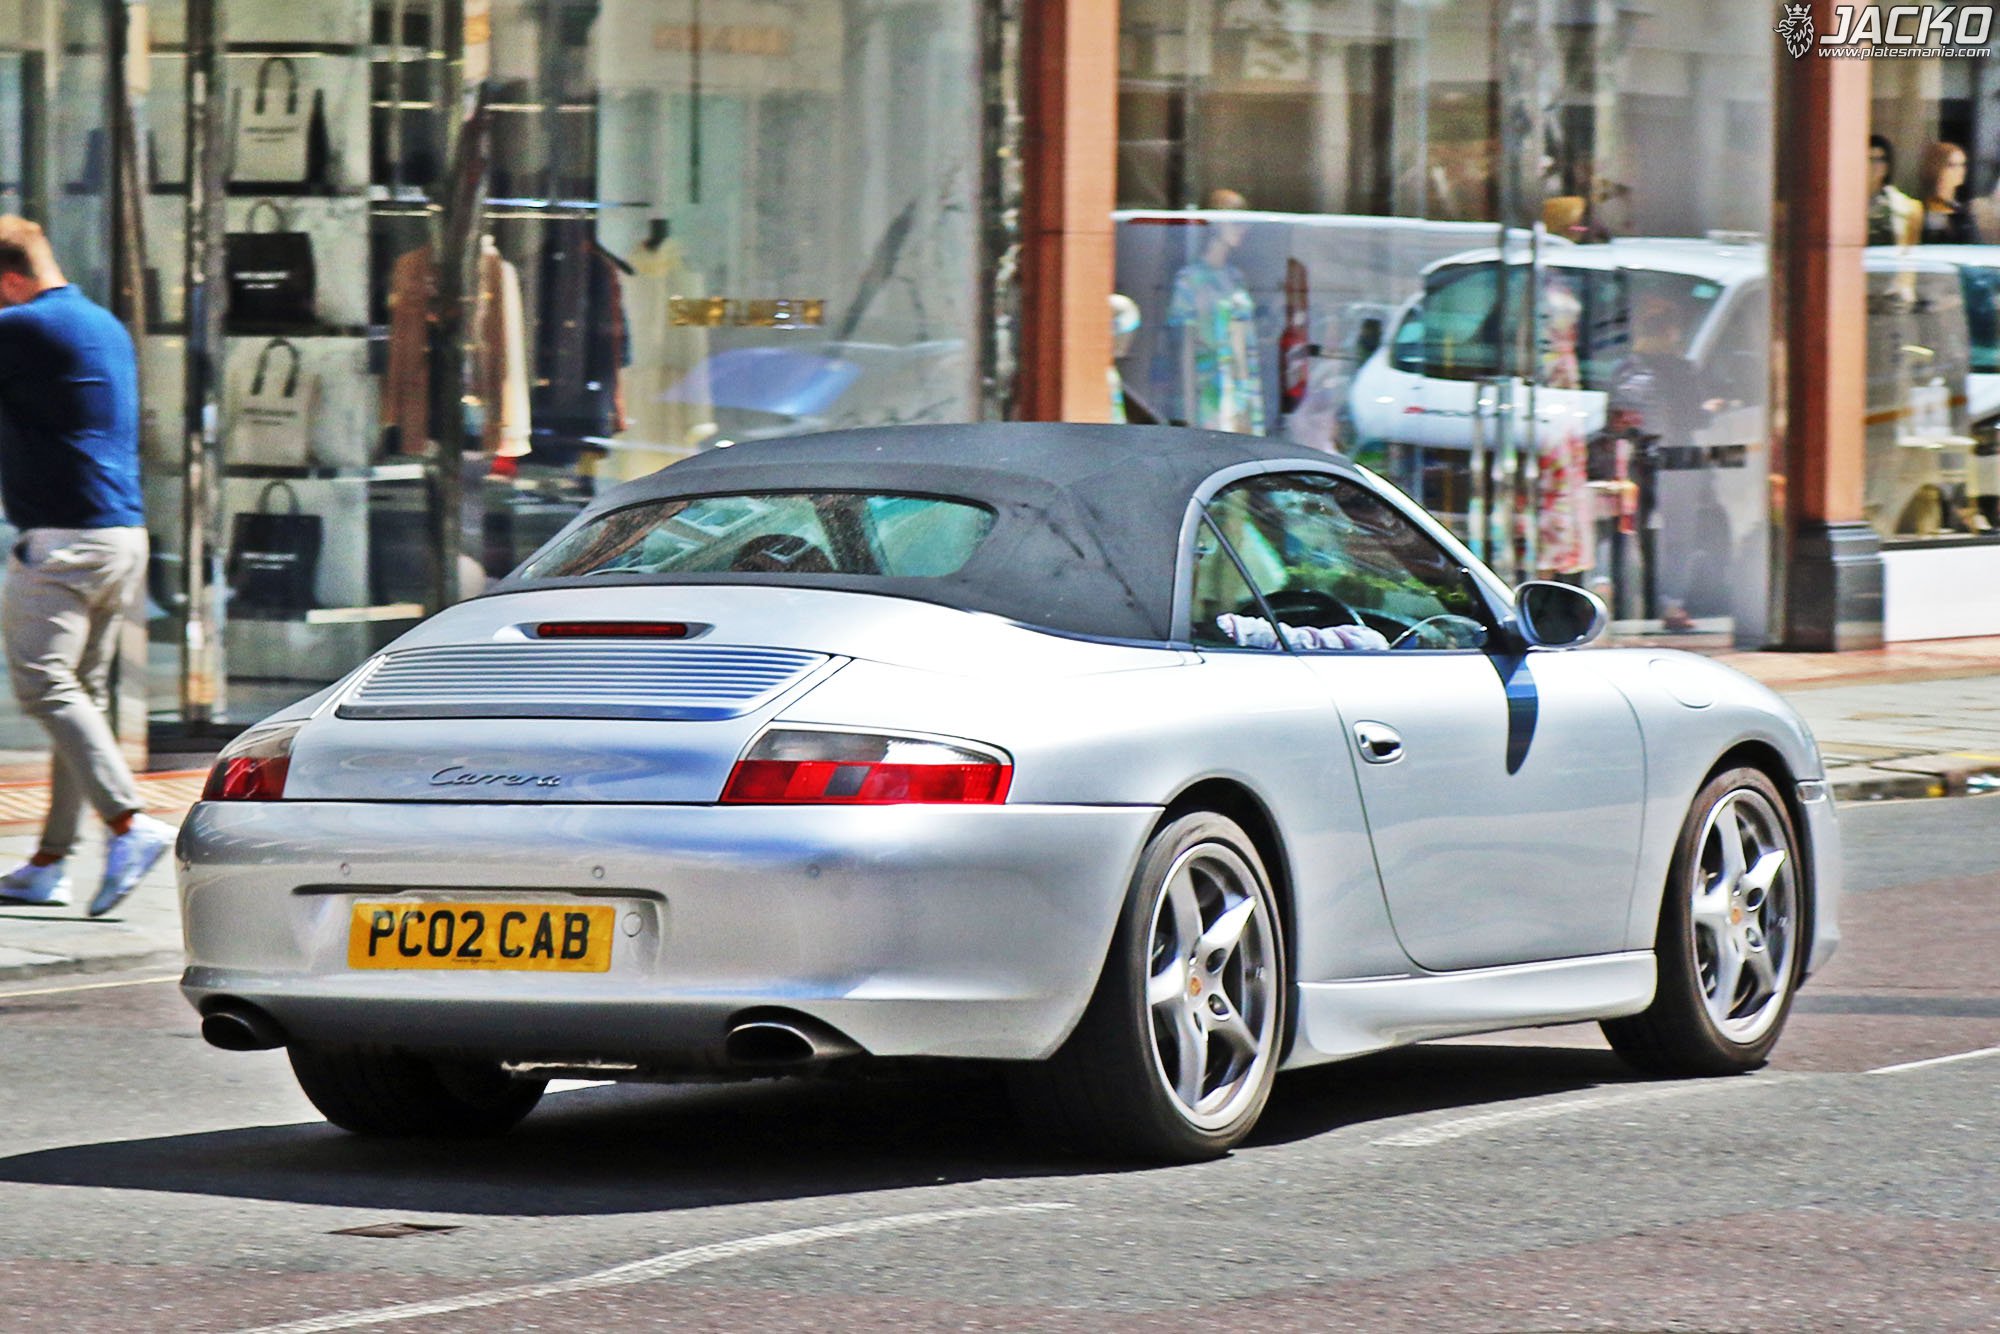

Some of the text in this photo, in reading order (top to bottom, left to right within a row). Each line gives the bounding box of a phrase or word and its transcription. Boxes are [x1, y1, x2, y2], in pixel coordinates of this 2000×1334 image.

[430, 766, 561, 787] Carrera
[368, 910, 590, 960] PC02 CAB
